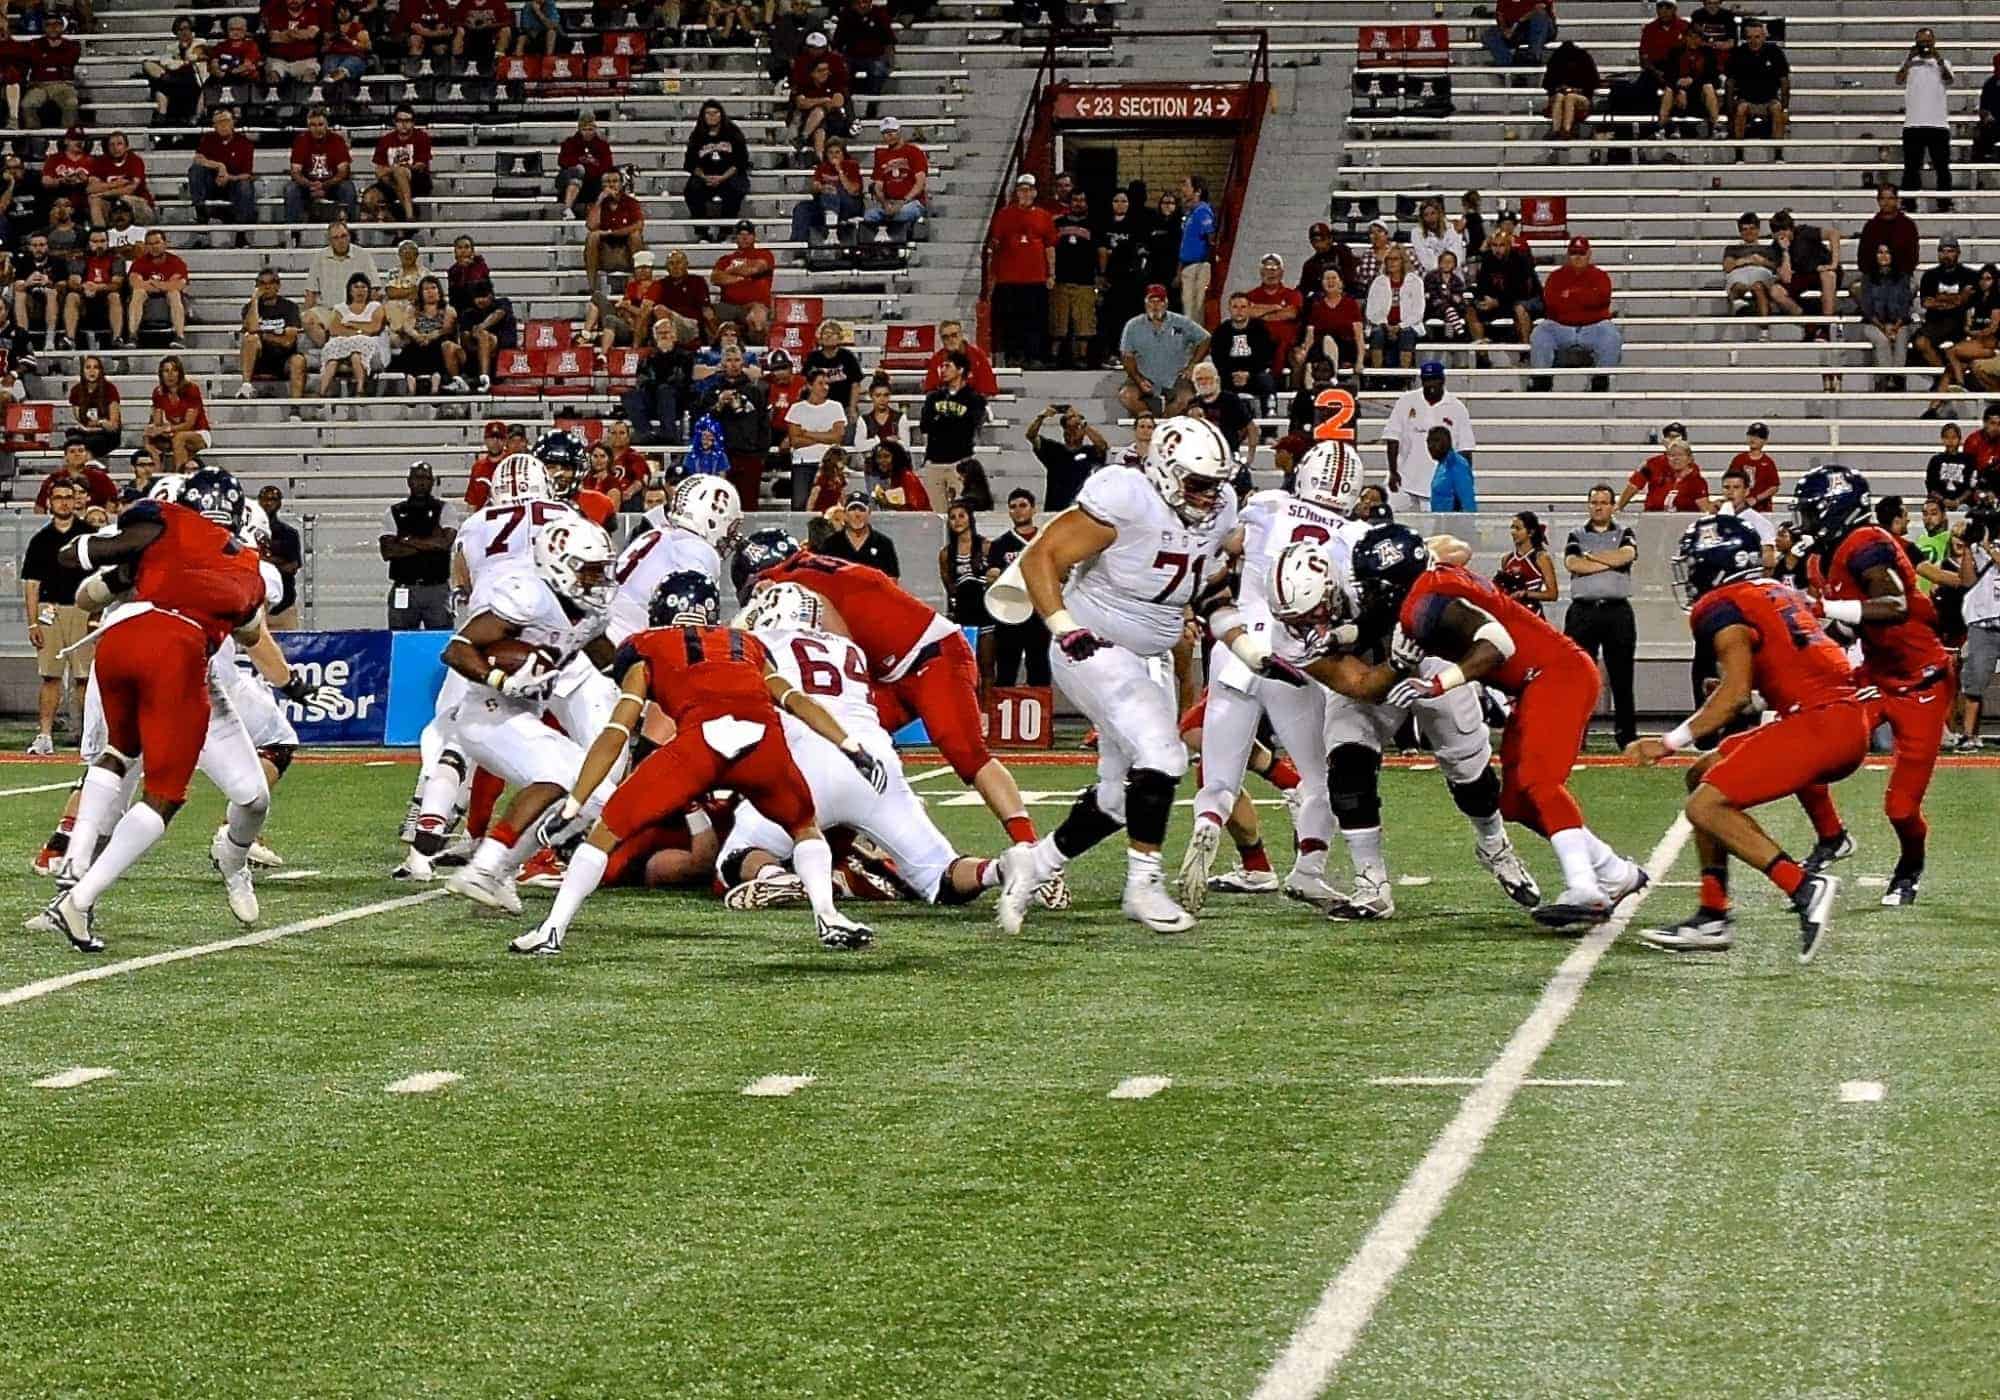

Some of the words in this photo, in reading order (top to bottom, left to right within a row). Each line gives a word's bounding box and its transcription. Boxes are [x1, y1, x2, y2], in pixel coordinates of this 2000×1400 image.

[1094, 97, 1113, 116] 23
[1119, 97, 1187, 117] SECTION
[1194, 97, 1213, 116] 24
[1314, 389, 1355, 440] 2
[1153, 550, 1206, 604] 71
[998, 699, 1041, 741] 10
